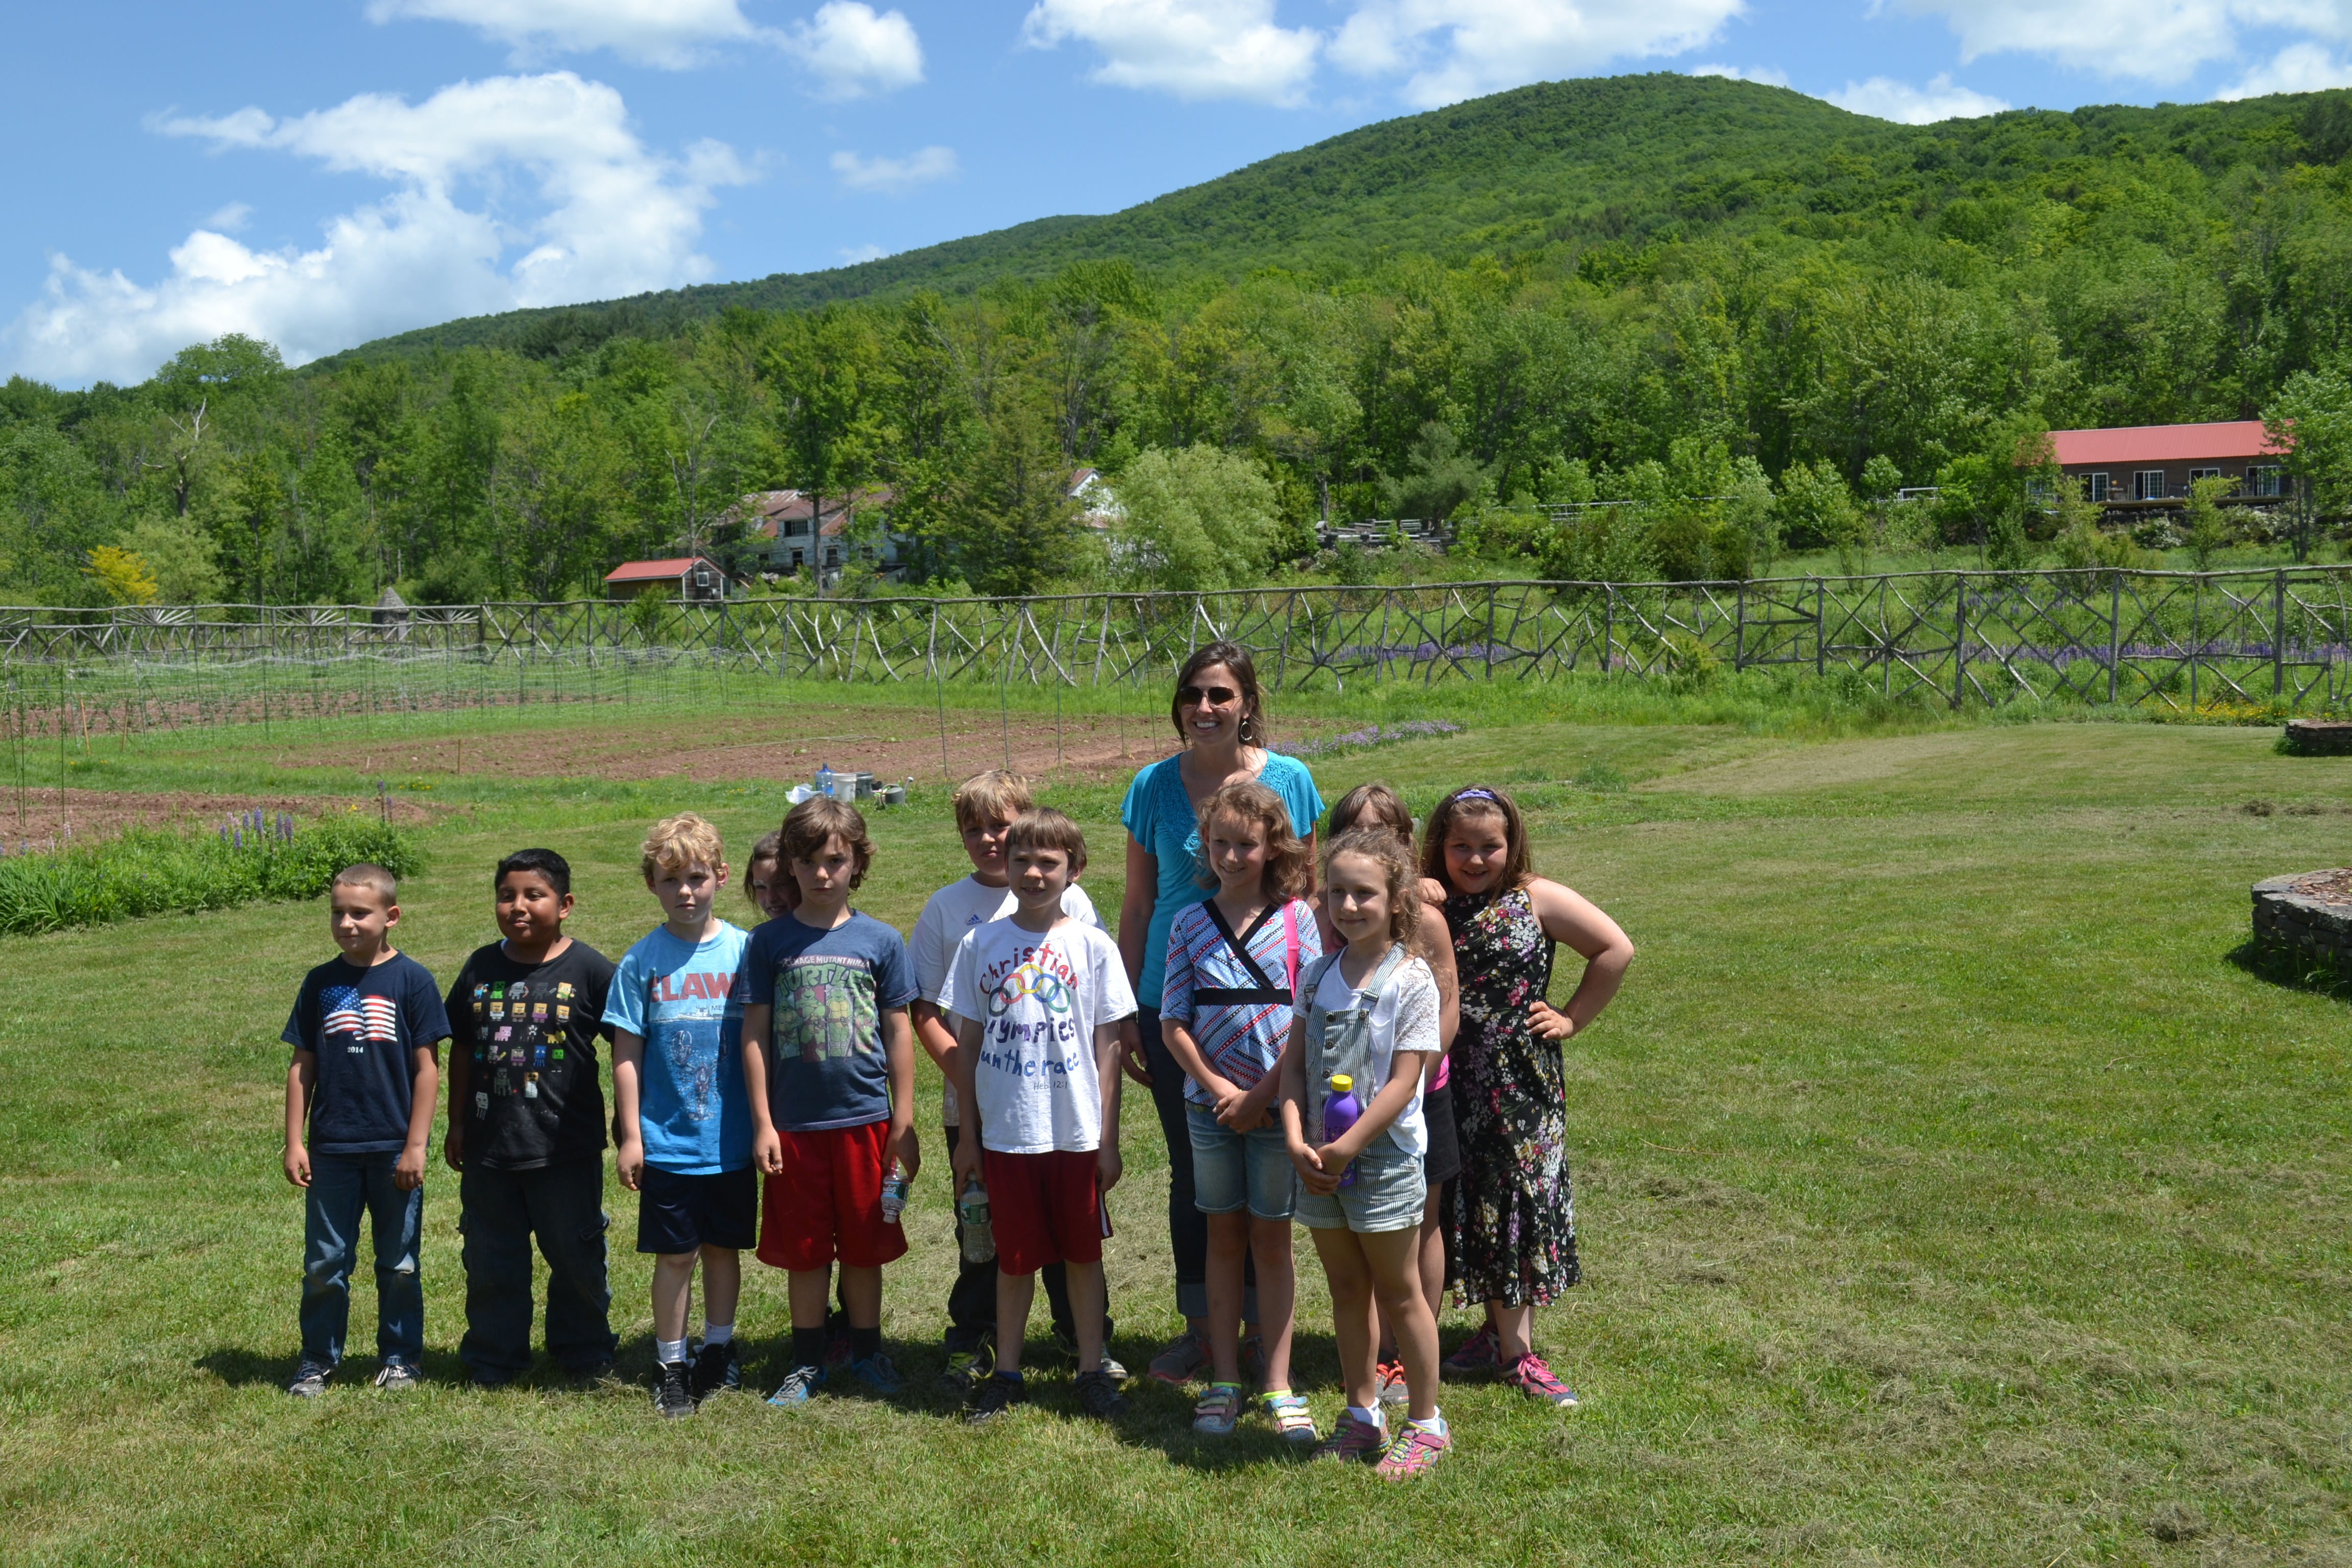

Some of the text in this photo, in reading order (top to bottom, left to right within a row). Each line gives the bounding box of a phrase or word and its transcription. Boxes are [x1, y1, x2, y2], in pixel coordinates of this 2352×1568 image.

[816, 955, 846, 964] MUTANT
[847, 958, 869, 968] NINJA
[979, 943, 1078, 994] Christian
[648, 972, 740, 1003] CLAW
[775, 963, 873, 996] TURTLES
[984, 1017, 1074, 1043] lympics
[981, 1049, 1079, 1076] un the race
[1034, 1081, 1067, 1090] Heb. 12:1
